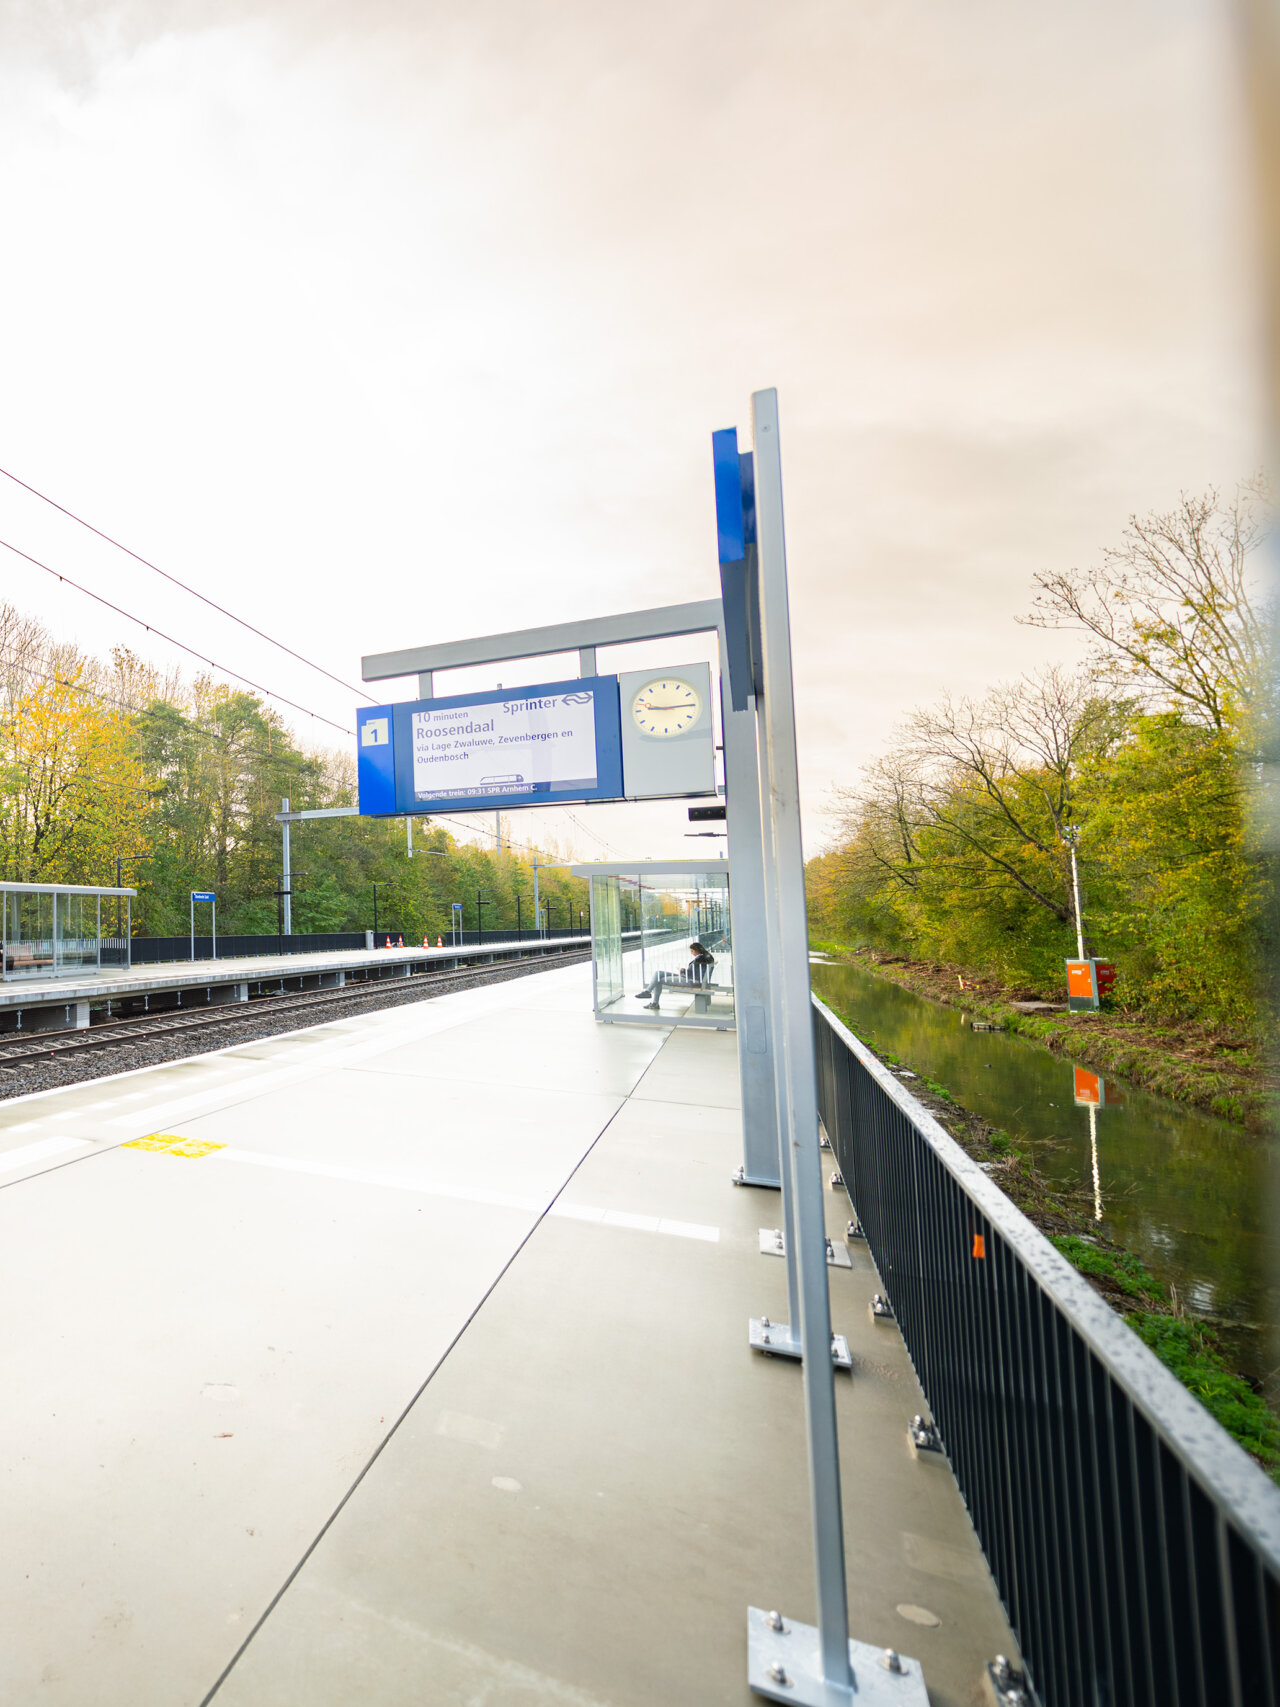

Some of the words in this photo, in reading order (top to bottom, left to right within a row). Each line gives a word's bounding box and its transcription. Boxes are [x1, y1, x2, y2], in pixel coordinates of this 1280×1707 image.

[503, 698, 558, 715] Sprinter
[416, 711, 431, 723] 10
[433, 711, 469, 722] minuten
[370, 728, 378, 744] 1
[416, 718, 495, 739] Roosendaal
[416, 744, 429, 752] via
[431, 742, 452, 752] Lage
[453, 738, 495, 749] Zwaluwe,
[498, 730, 559, 744] Zevenbergen
[561, 730, 573, 738] en
[416, 751, 469, 764] Oudenbosch
[417, 790, 448, 799] Volgende
[449, 788, 466, 797] trein:
[467, 787, 486, 796] 09:31
[487, 786, 501, 794] SPR
[502, 784, 529, 793] Arnhem
